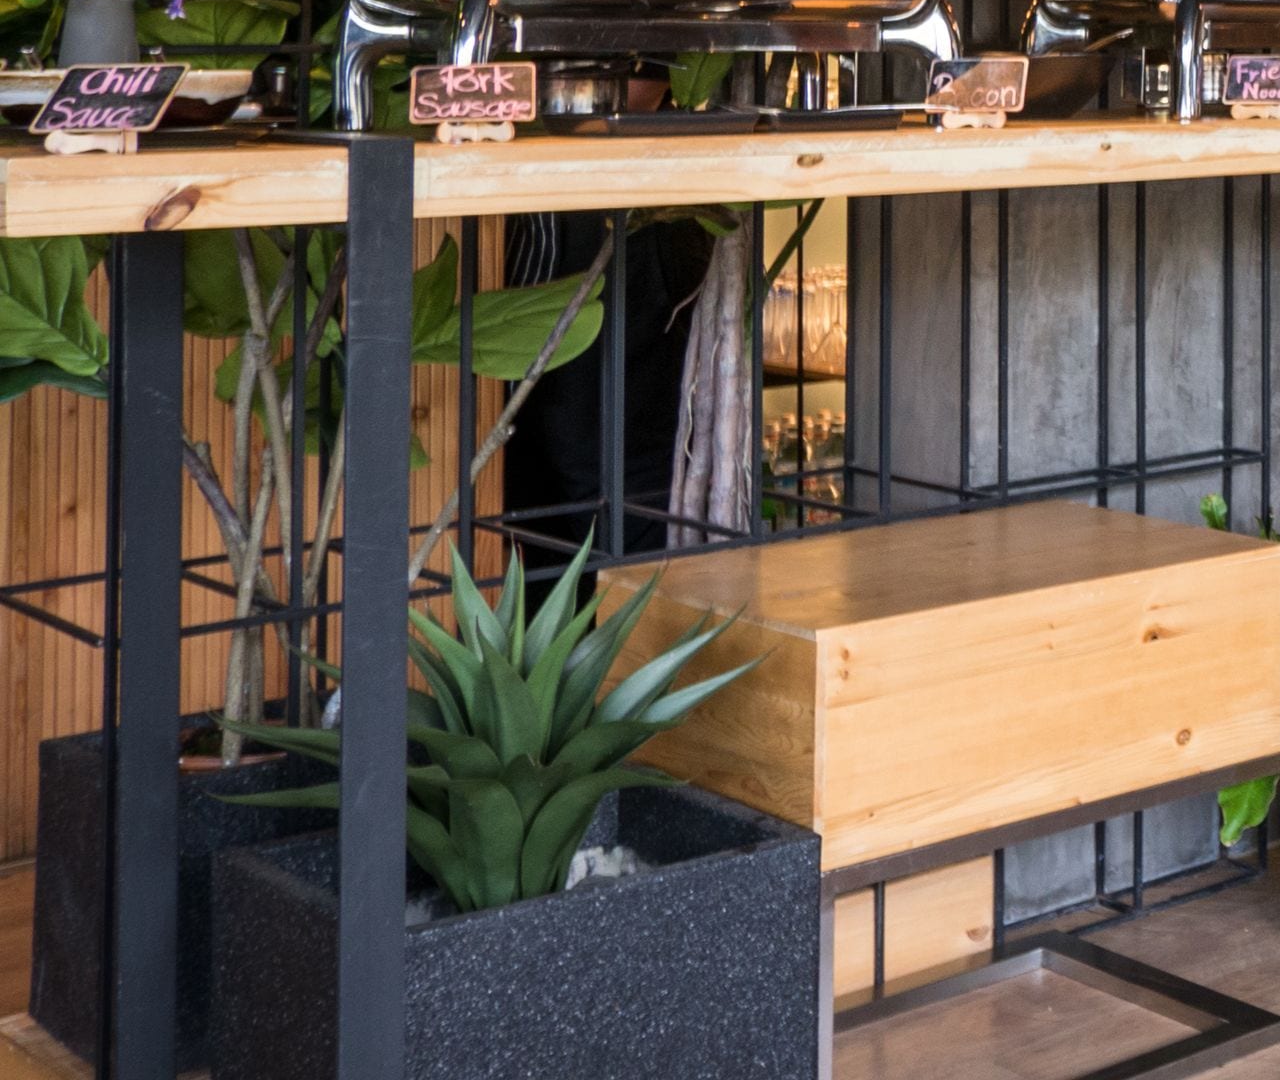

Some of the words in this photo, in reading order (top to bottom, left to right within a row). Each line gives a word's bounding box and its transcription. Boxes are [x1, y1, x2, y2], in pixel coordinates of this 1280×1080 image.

[80, 67, 161, 96] Chili
[440, 66, 516, 98] Pork
[414, 92, 531, 120] Sausage
